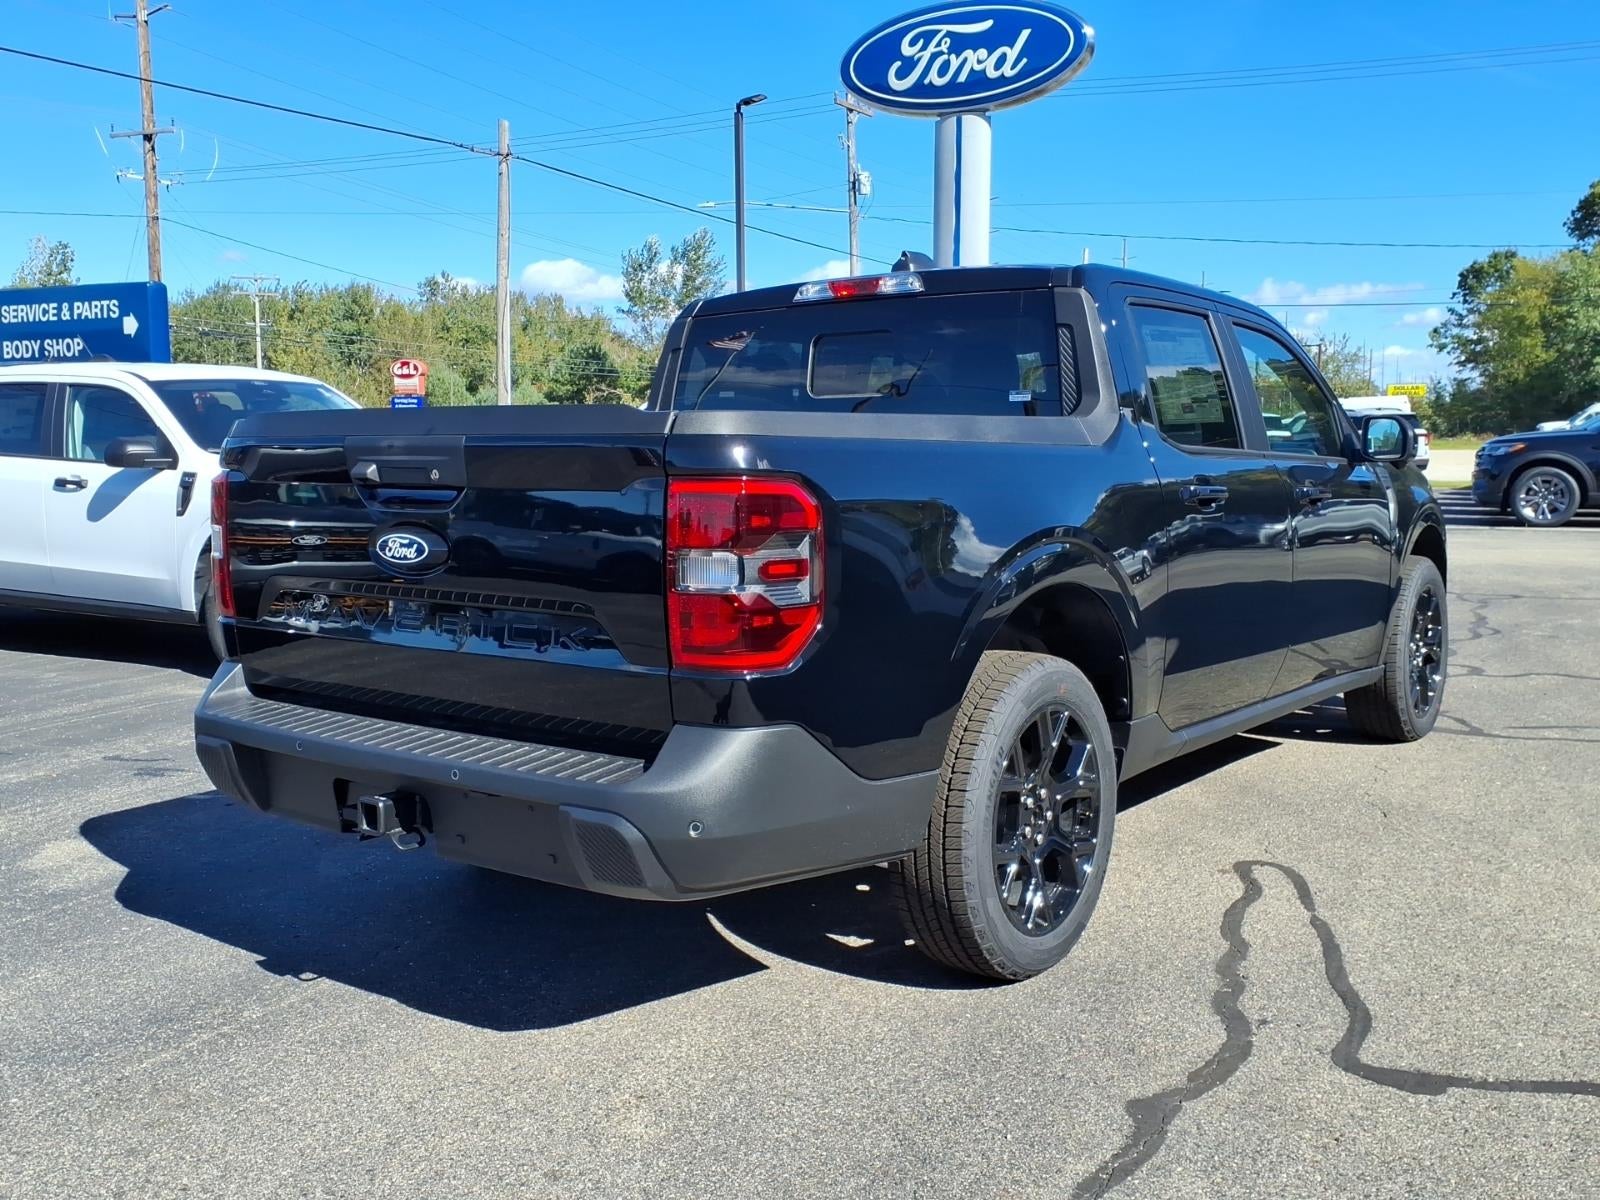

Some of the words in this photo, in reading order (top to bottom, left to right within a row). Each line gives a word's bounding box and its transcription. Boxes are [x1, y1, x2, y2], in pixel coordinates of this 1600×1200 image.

[887, 19, 1032, 91] Ford
[1, 304, 57, 323] SERVICE
[61, 302, 71, 320] &
[73, 299, 119, 319] PARTS
[3, 339, 41, 359] BODY
[44, 338, 84, 358] SHOP
[385, 537, 418, 559] Ford
